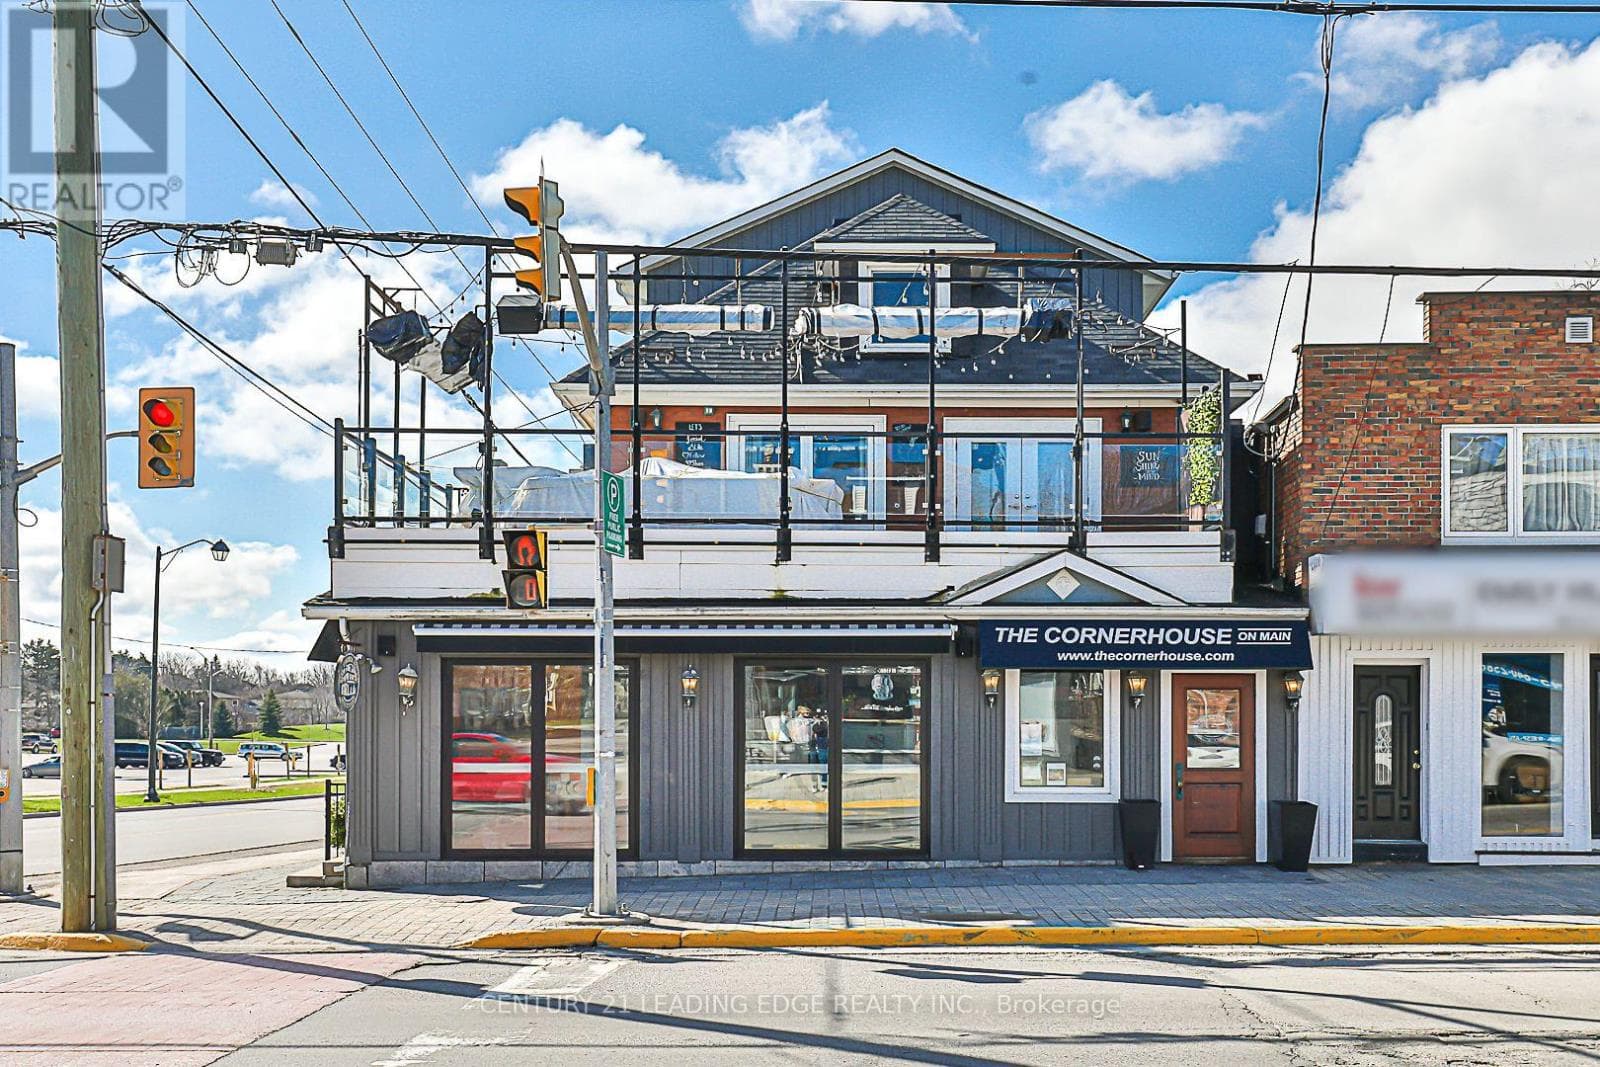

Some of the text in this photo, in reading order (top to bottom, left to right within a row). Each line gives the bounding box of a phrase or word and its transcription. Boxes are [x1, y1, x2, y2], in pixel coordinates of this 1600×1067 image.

[1136, 450, 1161, 462] SUN
[994, 626, 1291, 645] THE CORNERHOUSE ON MAIN
[1056, 650, 1235, 662] www.thecornerhouse.com
